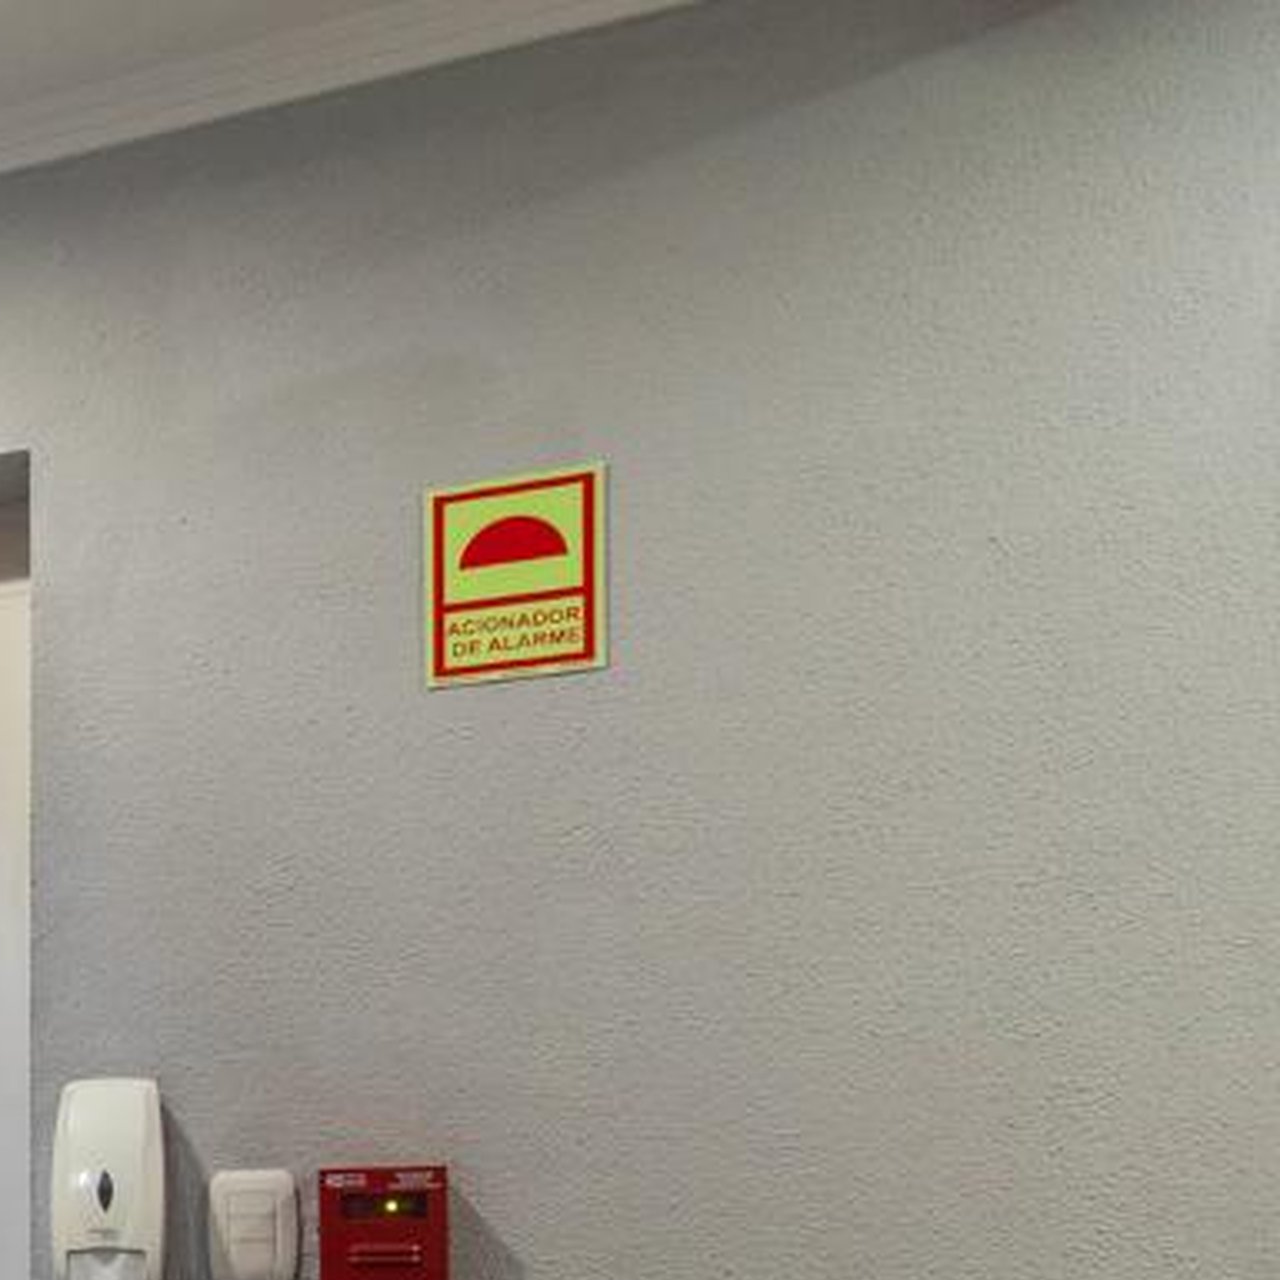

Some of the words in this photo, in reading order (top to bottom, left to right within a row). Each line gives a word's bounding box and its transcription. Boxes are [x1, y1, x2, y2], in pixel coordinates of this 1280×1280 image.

[448, 605, 581, 637] ACIONADOR
[452, 639, 481, 658] DE
[489, 626, 582, 653] ALARME
